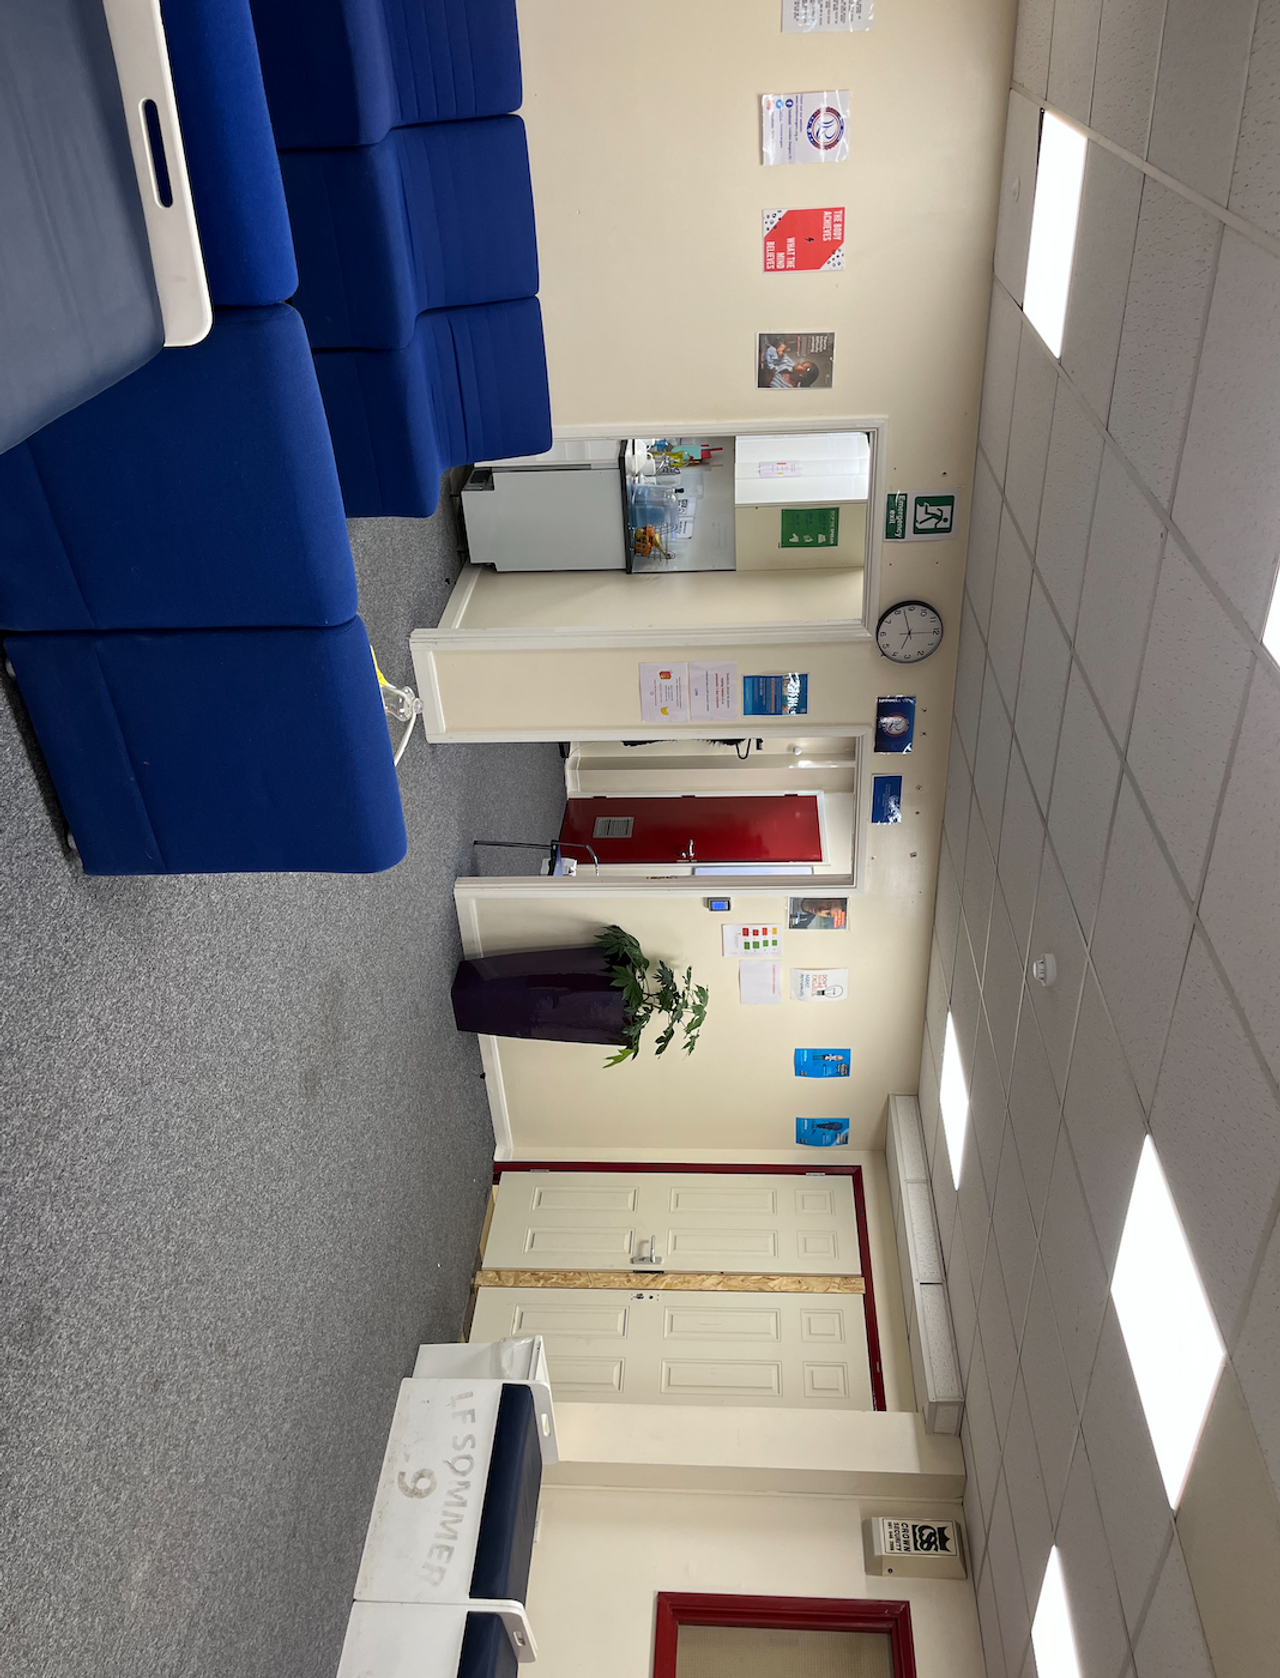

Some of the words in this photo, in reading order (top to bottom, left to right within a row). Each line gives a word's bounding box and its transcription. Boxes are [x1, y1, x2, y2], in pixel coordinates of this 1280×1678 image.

[823, 211, 832, 242] ACHIEVES
[833, 210, 842, 222] THE
[786, 237, 795, 255] WHAT
[833, 223, 842, 241] BODY
[766, 241, 775, 270] BELIEVES
[776, 252, 785, 269] MIND
[786, 257, 795, 269] THE
[895, 495, 906, 537] Emergency
[920, 608, 927, 617] 10
[397, 1468, 438, 1500] 9
[417, 1433, 476, 1587] SOMMER
[893, 1522, 902, 1551] SECURITY
[901, 1522, 911, 1552] CROWN
